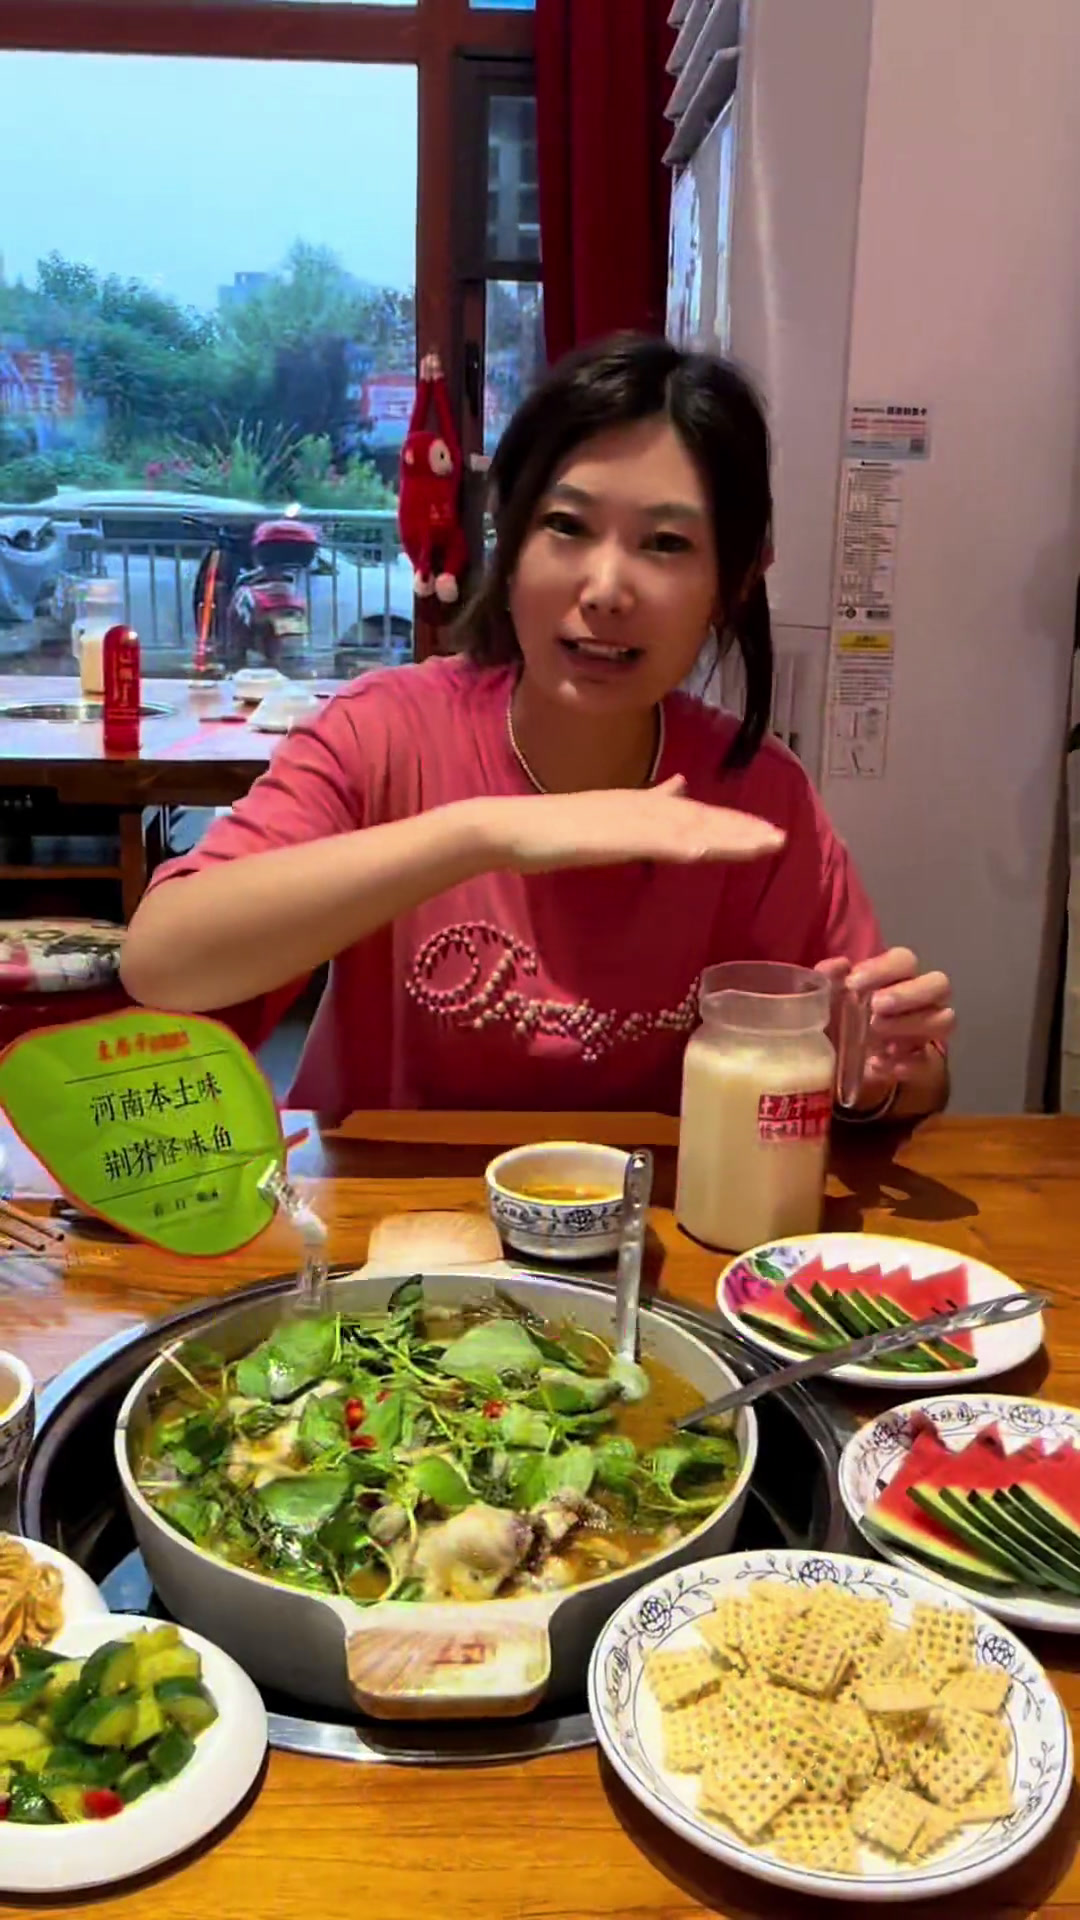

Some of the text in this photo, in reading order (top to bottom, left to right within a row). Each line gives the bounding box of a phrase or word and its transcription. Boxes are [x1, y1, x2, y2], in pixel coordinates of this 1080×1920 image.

[91, 1072, 222, 1126] 河南本土味
[105, 1125, 232, 1180] 荆芥怪味鱼
